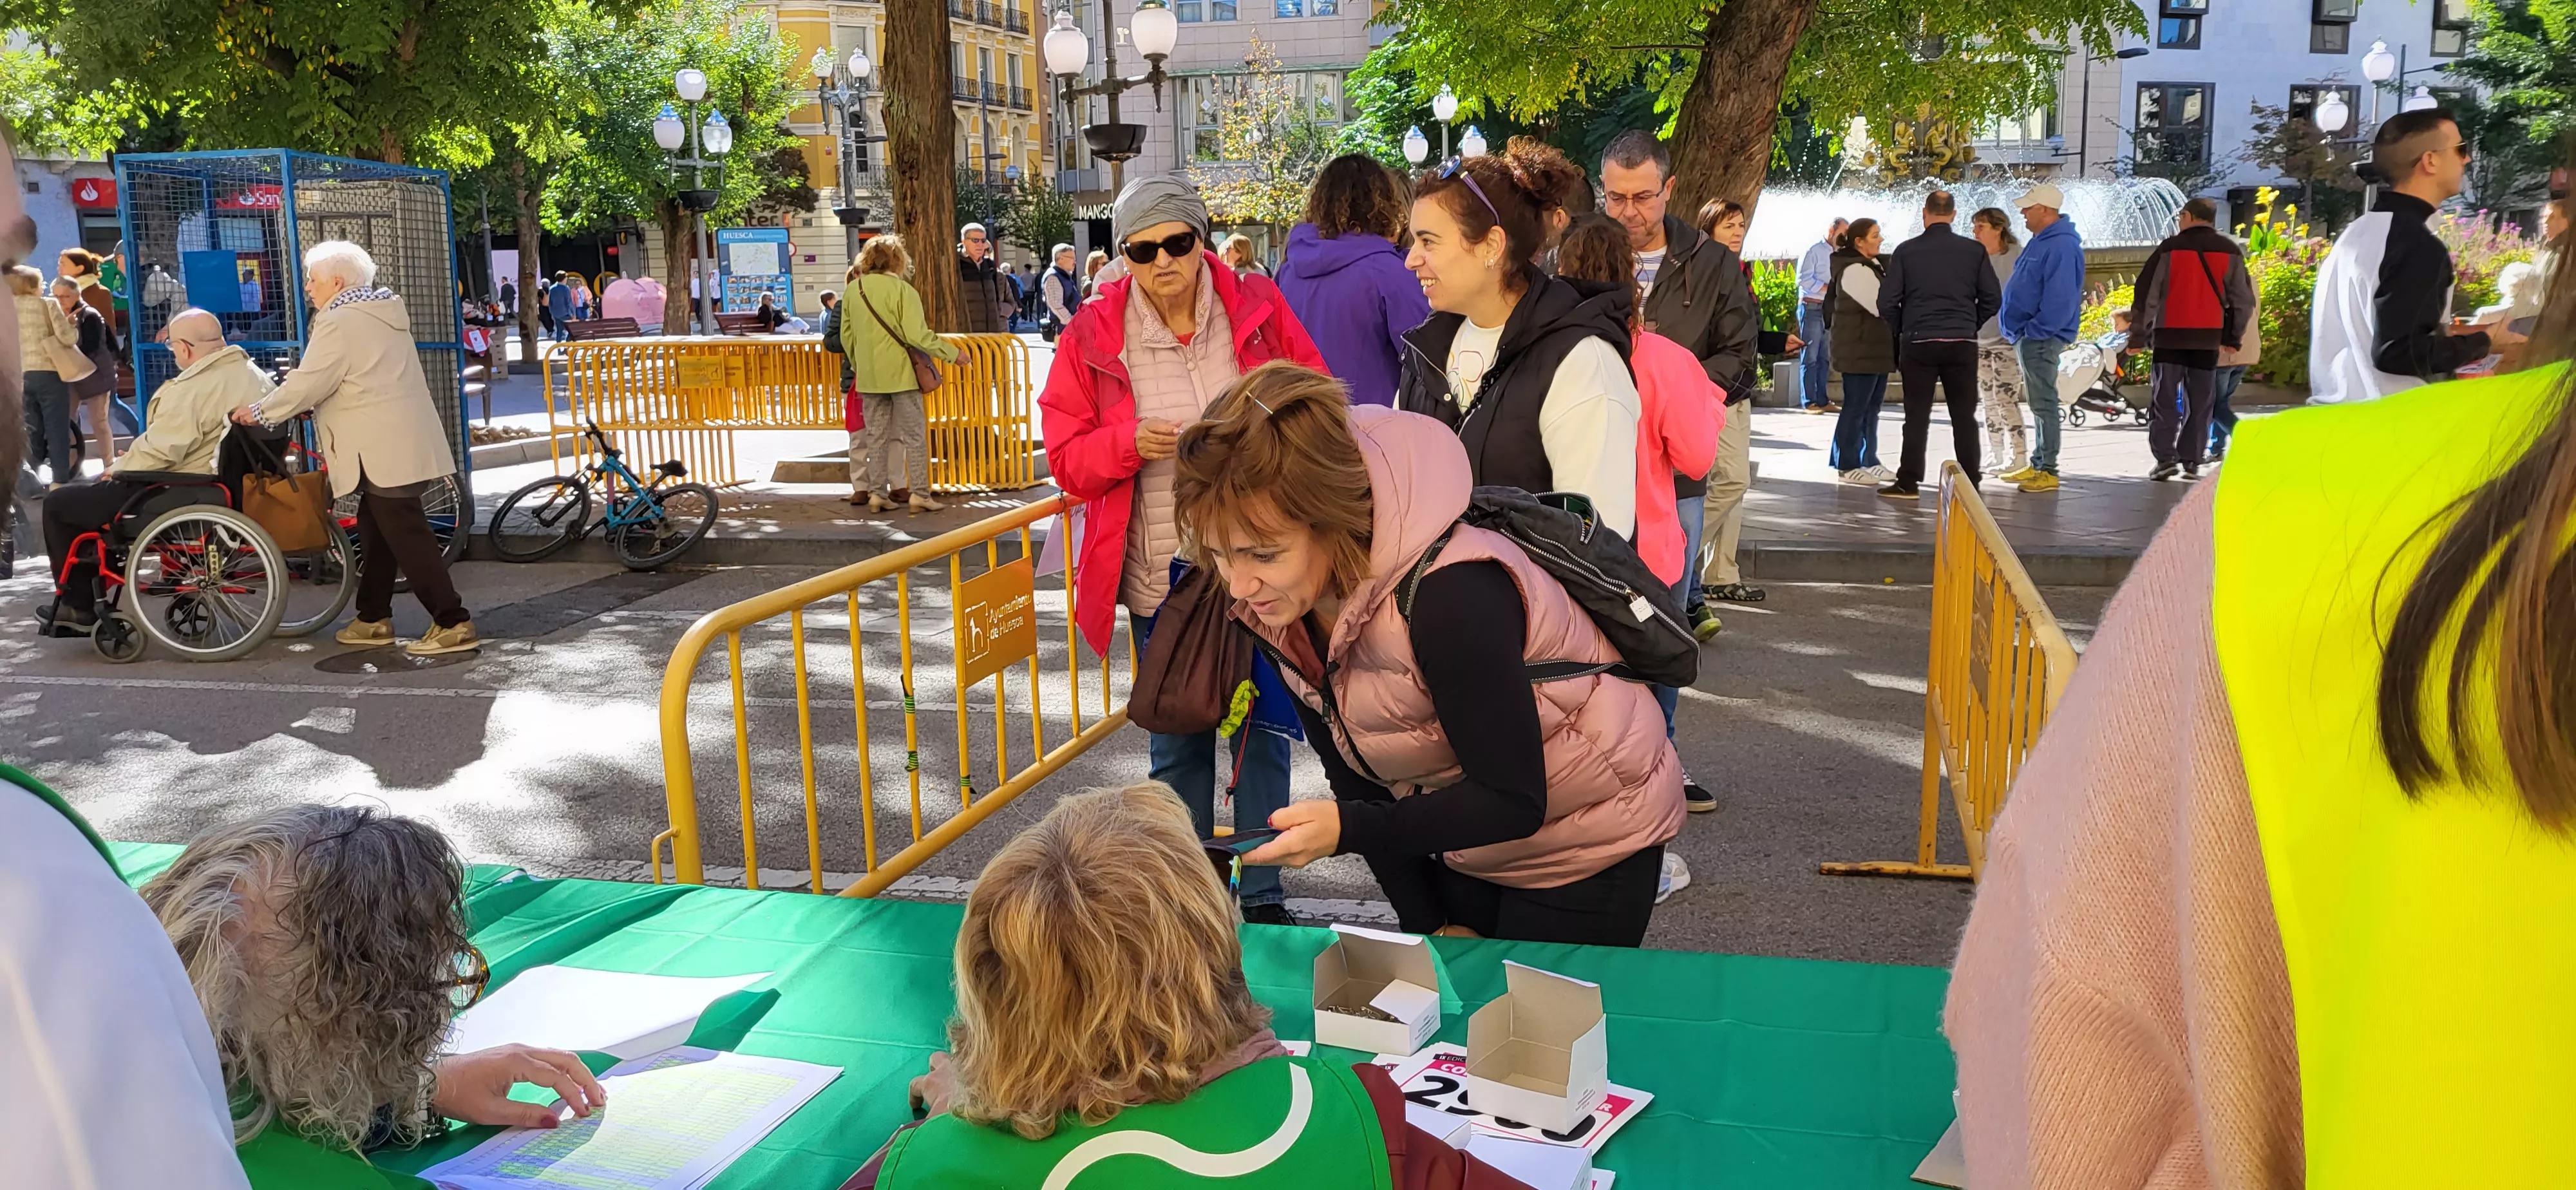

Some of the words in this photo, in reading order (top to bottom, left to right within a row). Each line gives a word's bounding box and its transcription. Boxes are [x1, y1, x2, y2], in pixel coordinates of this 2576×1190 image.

[256, 191, 280, 206] San
[1079, 203, 1114, 220] MANGO
[989, 592, 1032, 624] Ayuntamiento
[990, 626, 999, 639] de
[999, 616, 1024, 636] Huesca
[1441, 1062, 1468, 1076] CO
